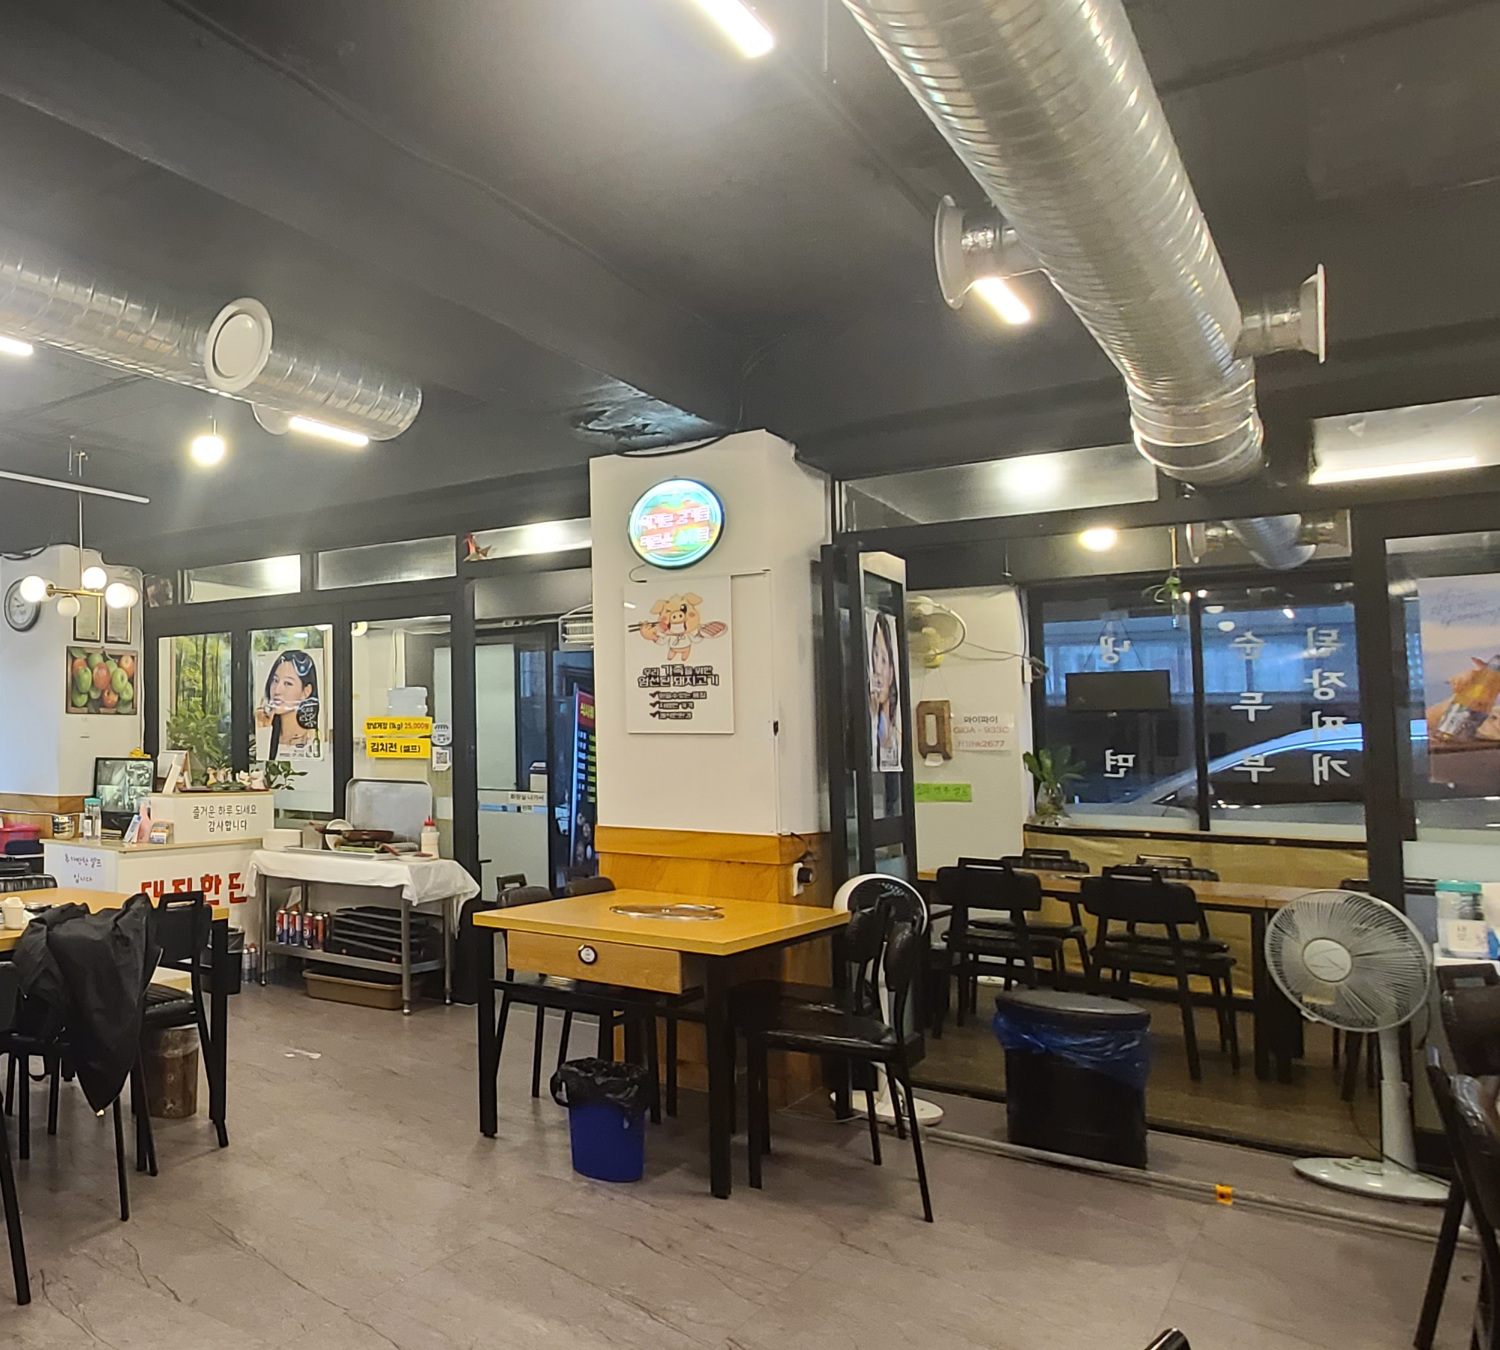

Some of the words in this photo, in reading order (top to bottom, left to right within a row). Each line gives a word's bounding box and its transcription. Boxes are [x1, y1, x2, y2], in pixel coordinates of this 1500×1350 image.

[643, 667, 660, 676] 우리
[638, 676, 671, 687] 엄선된
[673, 674, 719, 687] 돼지고기
[984, 726, 1009, 734] 933C
[370, 742, 397, 753] 김치전
[400, 744, 421, 753] (셀프)
[192, 806, 216, 819] 즐거운
[217, 805, 234, 816] 하루
[235, 804, 258, 816] 되세요
[207, 820, 248, 833] 감사합니다
